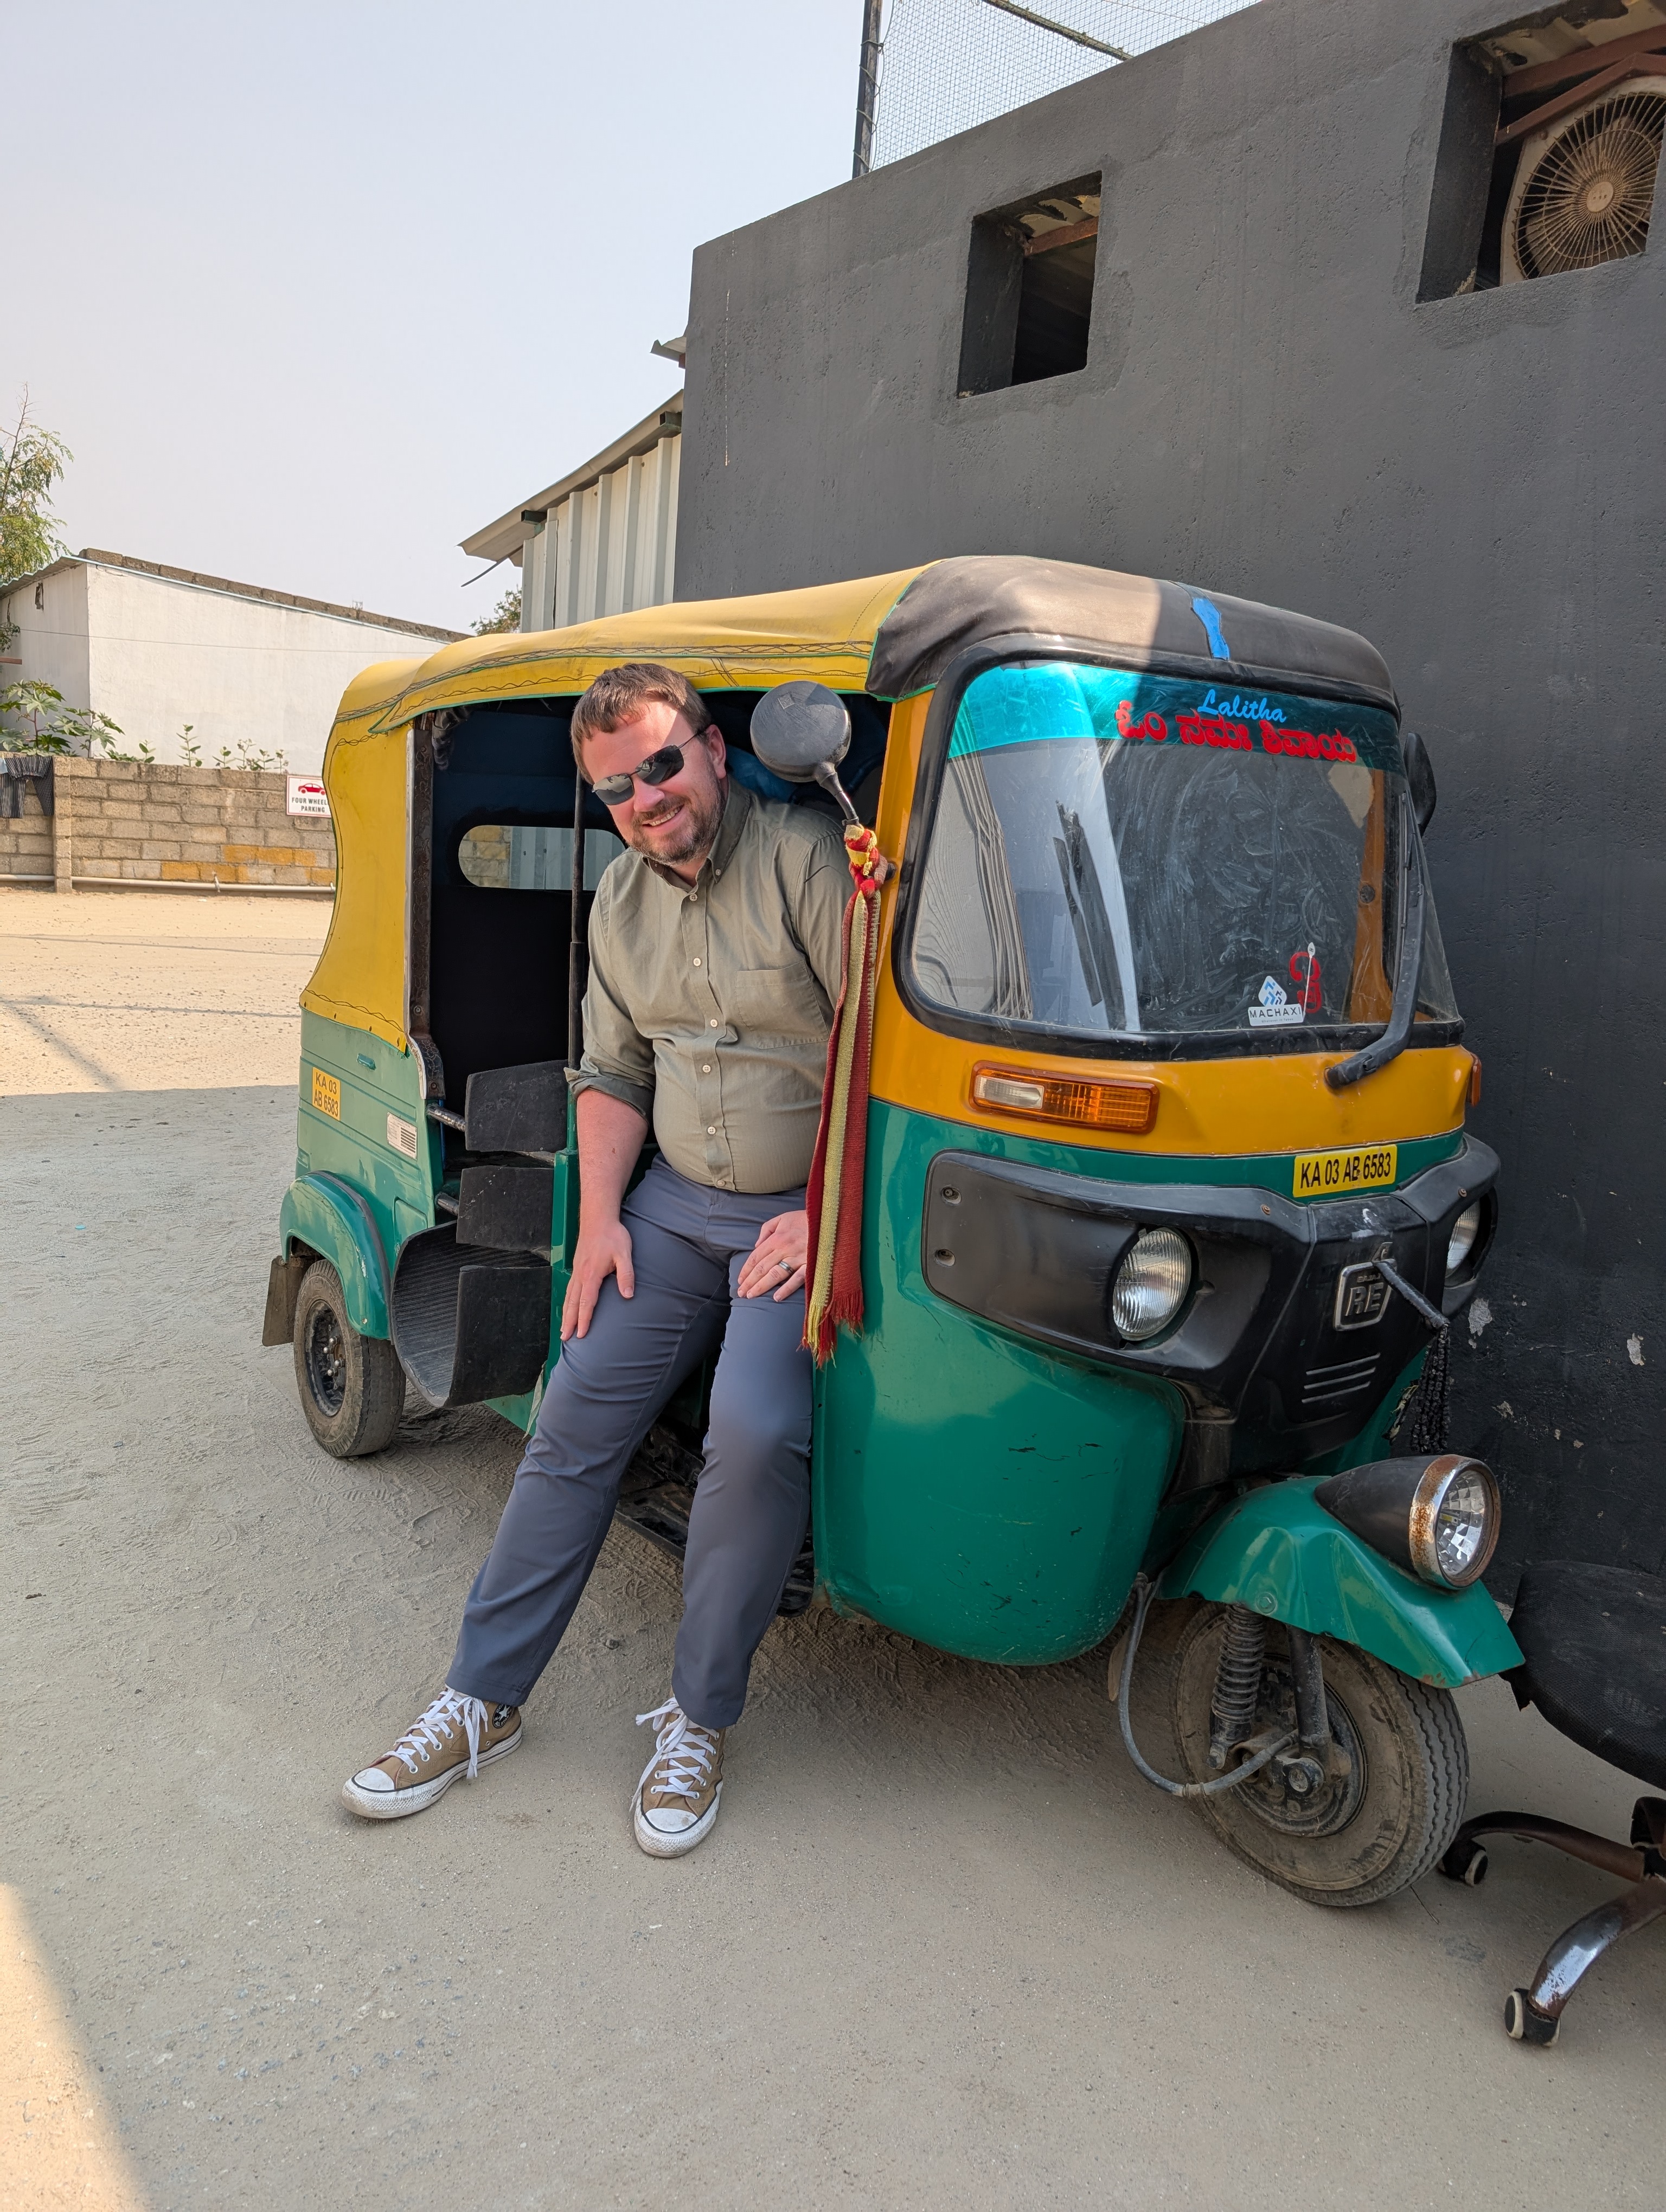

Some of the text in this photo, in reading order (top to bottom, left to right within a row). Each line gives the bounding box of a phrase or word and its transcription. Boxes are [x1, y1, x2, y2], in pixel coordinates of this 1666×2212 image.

[1197, 689, 1286, 723] Lalitha
[1114, 700, 1356, 763] ಓಂ ನಮಃ ಶಿವಾಯ
[1249, 1007, 1301, 1018] MACHAXI
[316, 1072, 337, 1095] KA 03
[313, 1089, 338, 1117] AB 6583
[1300, 1152, 1391, 1188] KA 03 AB 6583
[1345, 1282, 1384, 1316] RE
